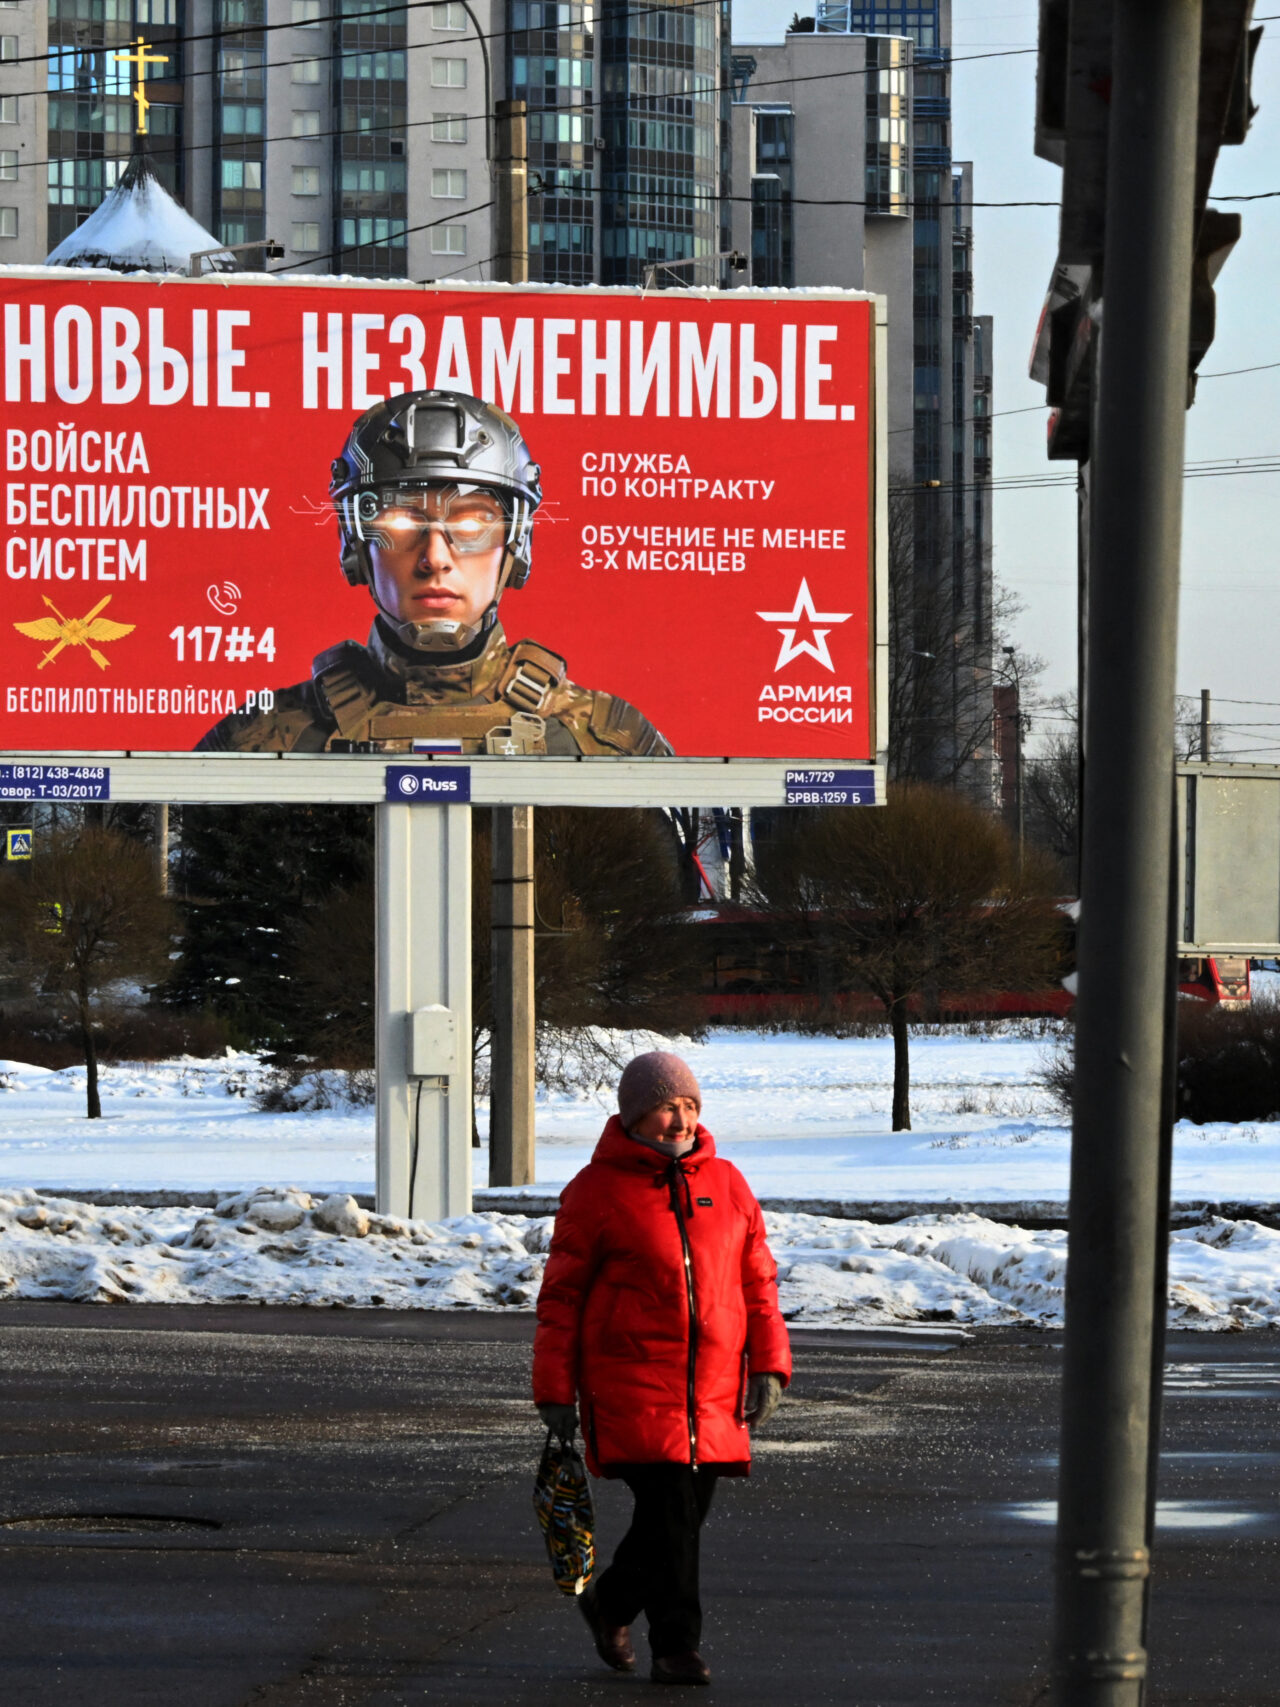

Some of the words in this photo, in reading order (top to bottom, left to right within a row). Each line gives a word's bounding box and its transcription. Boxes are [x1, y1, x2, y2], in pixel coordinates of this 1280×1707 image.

[4, 303, 270, 408] НОВЫЕ.
[303, 311, 855, 421] НЕЗАМЕНИМЫЕ.
[6, 423, 150, 474] ВОЙСКА
[581, 452, 691, 474] СЛУЖБА
[582, 476, 617, 497] ПО
[625, 478, 775, 500] КОНТРАКТУ
[6, 483, 271, 530] БЕСПИЛОТНЫХ
[581, 525, 715, 548] ОБУЧЕНИЕ
[723, 527, 755, 548] НЕ
[762, 528, 846, 550] МЕНЕЕ
[6, 536, 147, 581] СИСТЕМ
[581, 549, 619, 570] 3-Х
[626, 550, 746, 575] МЕСЯЦЕВ
[169, 625, 276, 663] 117#4
[6, 684, 275, 715] БЕСПИЛОТНЫЕВОЙСКА.РФ
[758, 685, 852, 703] АРМИЯ
[758, 706, 853, 724] РОССИИ
[13, 766, 43, 780] (812)
[47, 767, 104, 780] 438-4848
[422, 778, 458, 792] Russ
[0, 786, 36, 799] овор:
[852, 793, 861, 804] Б
